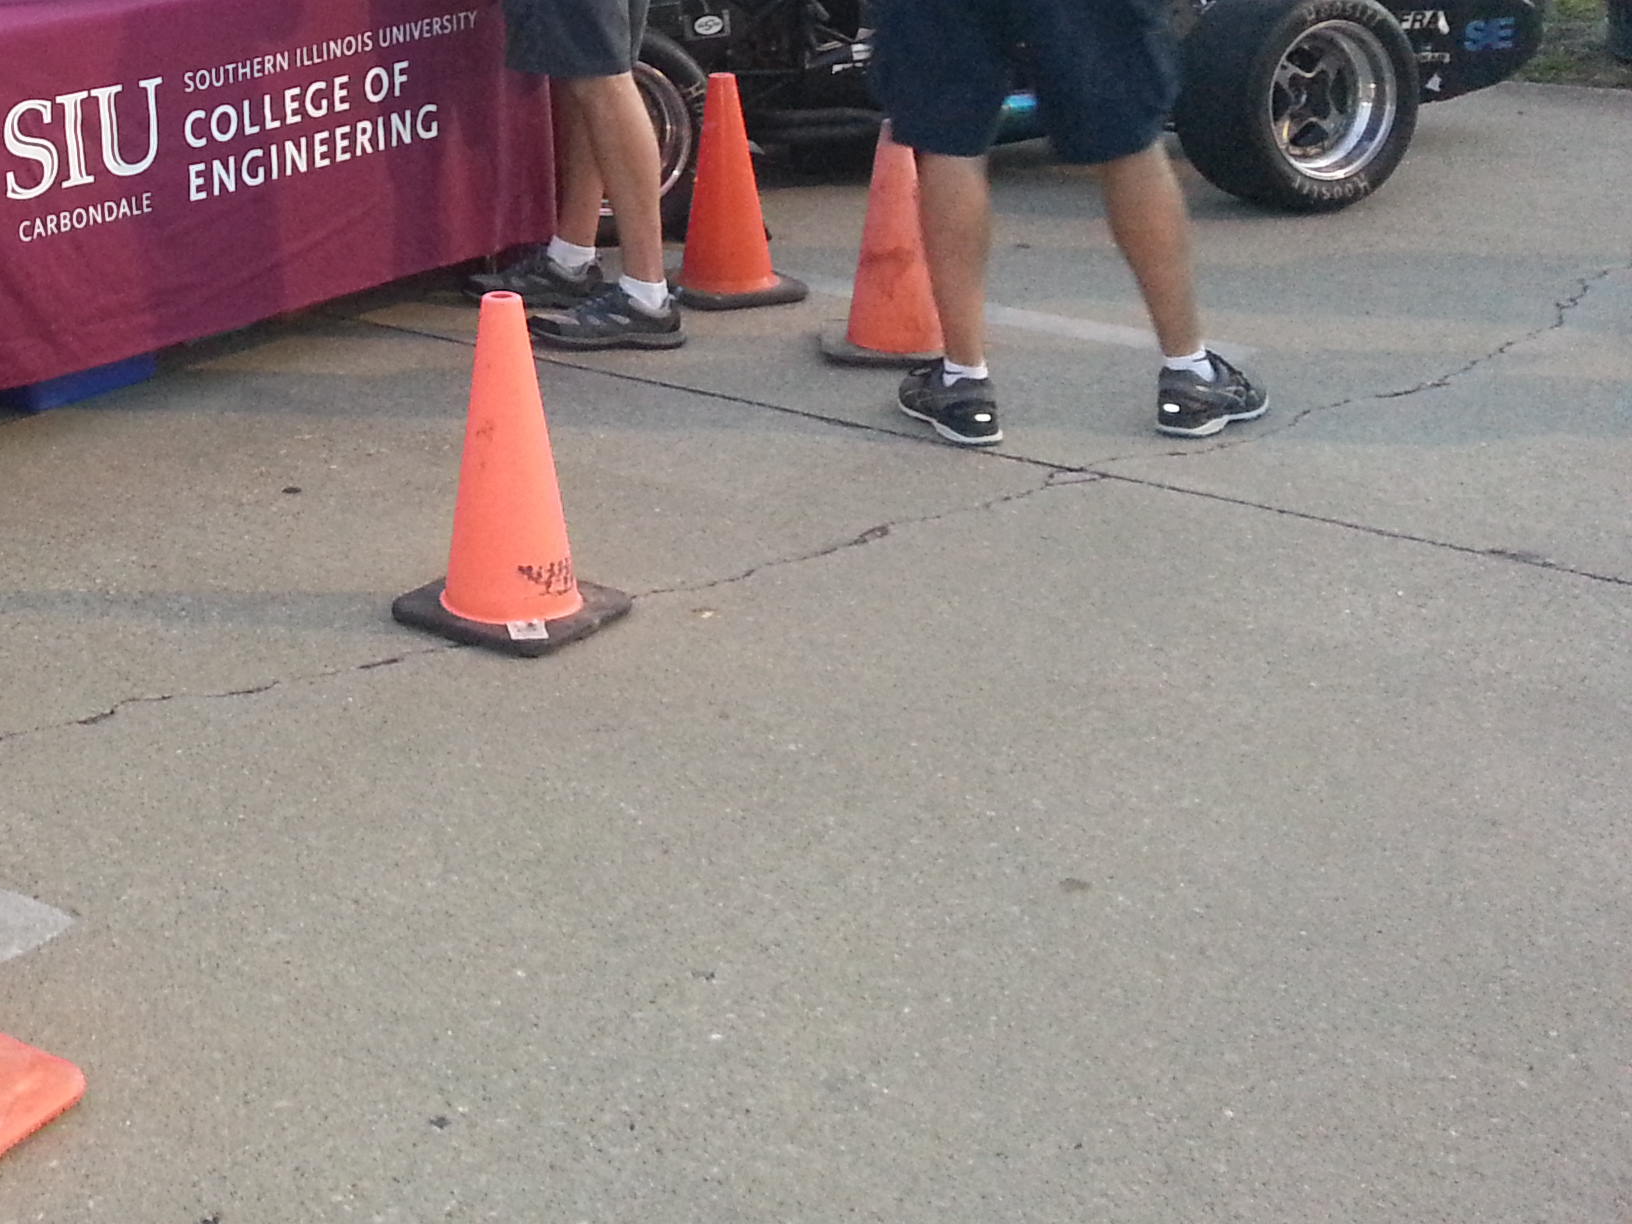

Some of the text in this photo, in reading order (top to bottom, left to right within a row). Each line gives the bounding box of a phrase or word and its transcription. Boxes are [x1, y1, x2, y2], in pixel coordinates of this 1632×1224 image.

[183, 9, 479, 94] SOUTHERN ILLINOIS UNIVERSITY
[1, 76, 164, 201] SIU
[183, 60, 411, 149] COLLEGE OF
[187, 102, 440, 202] ENGINEERING
[18, 191, 154, 243] CARBONDALE
